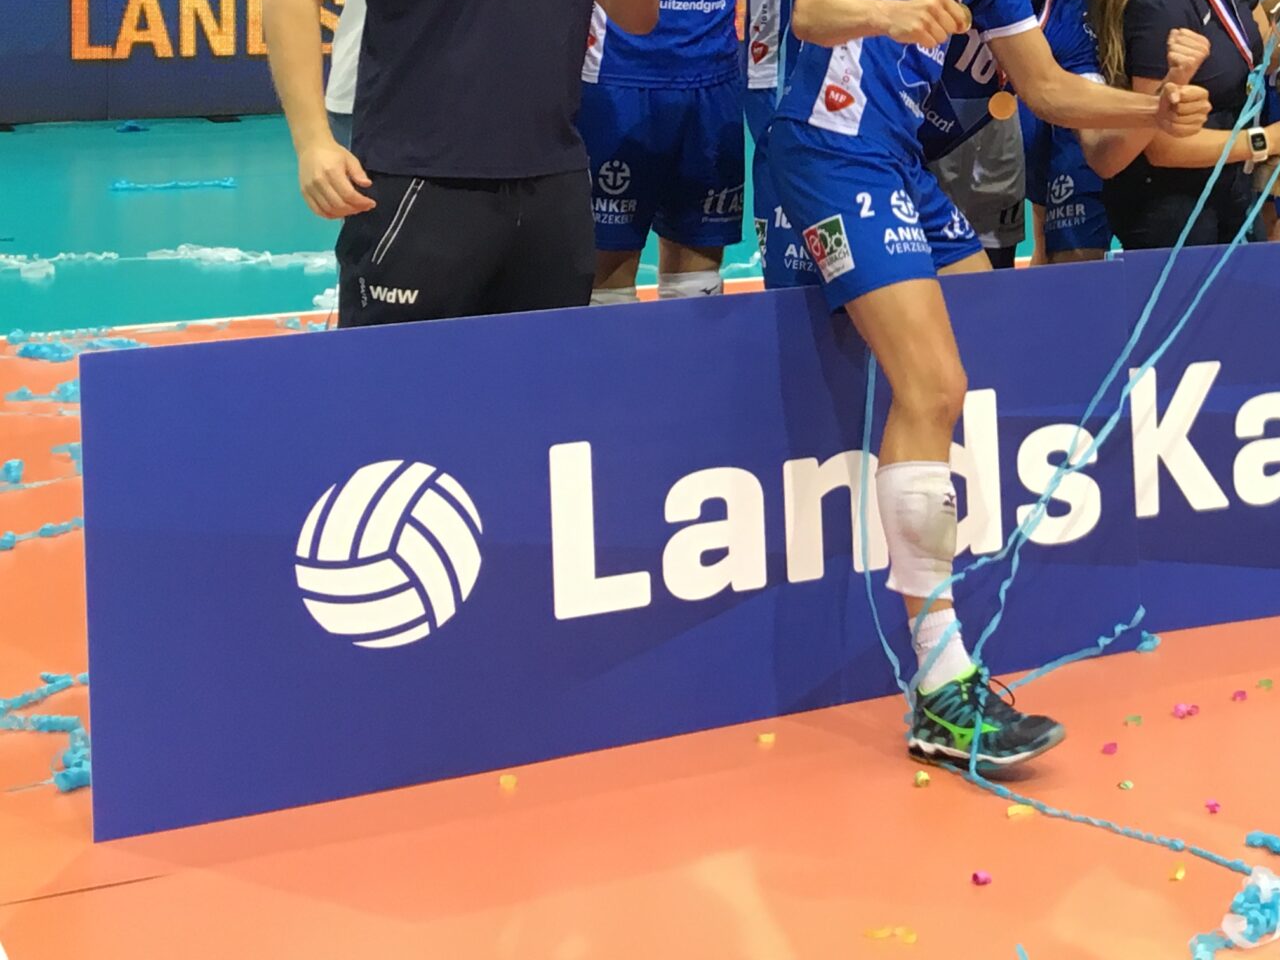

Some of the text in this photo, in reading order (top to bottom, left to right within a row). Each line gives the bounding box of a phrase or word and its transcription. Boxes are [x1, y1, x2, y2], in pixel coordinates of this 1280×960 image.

[594, 197, 638, 213] NKER
[855, 191, 876, 219] 2
[1046, 203, 1086, 220] NKER
[369, 285, 419, 304] WdW
